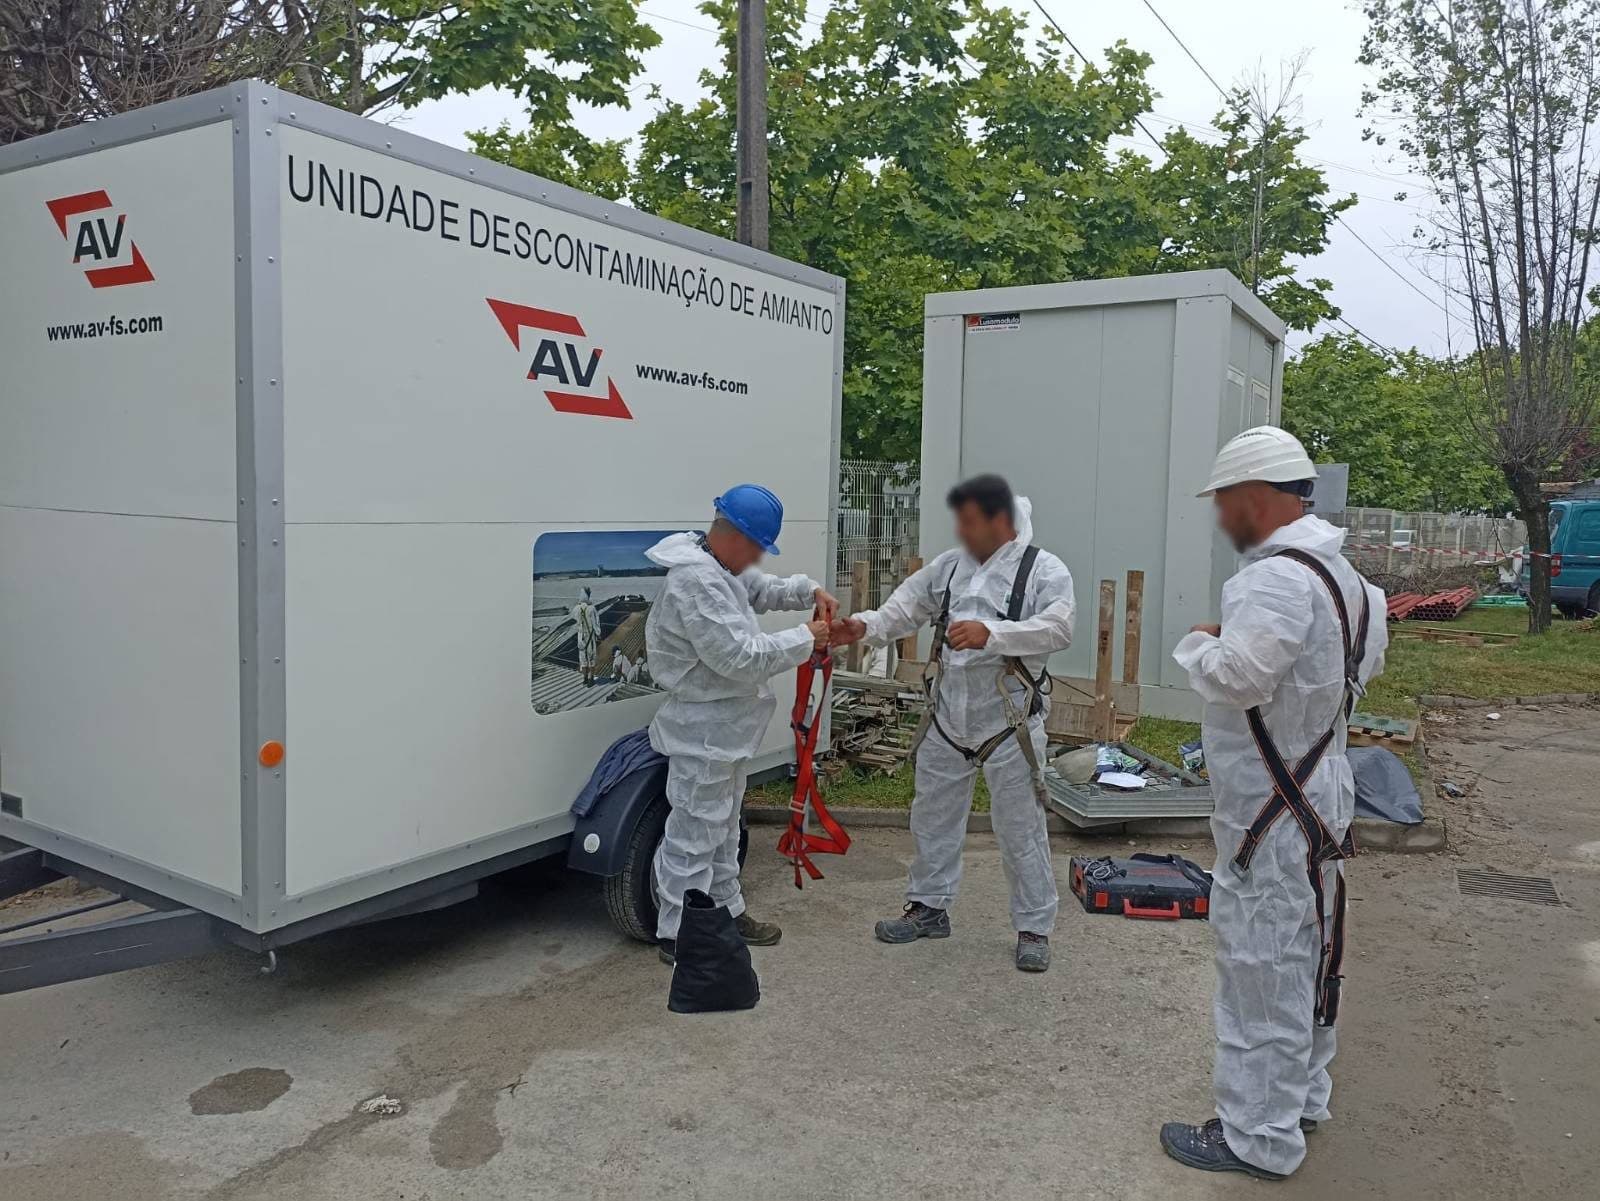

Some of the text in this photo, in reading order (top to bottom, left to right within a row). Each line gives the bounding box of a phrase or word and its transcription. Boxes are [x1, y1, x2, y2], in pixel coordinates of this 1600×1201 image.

[72, 213, 127, 264] AV
[288, 154, 833, 335] UNIDADE DESCONTAMINAÇÃO DE AMIANTO
[47, 315, 163, 341] www.av-fs.com
[526, 338, 603, 387] AV
[636, 363, 748, 395] www.av-fs.com
